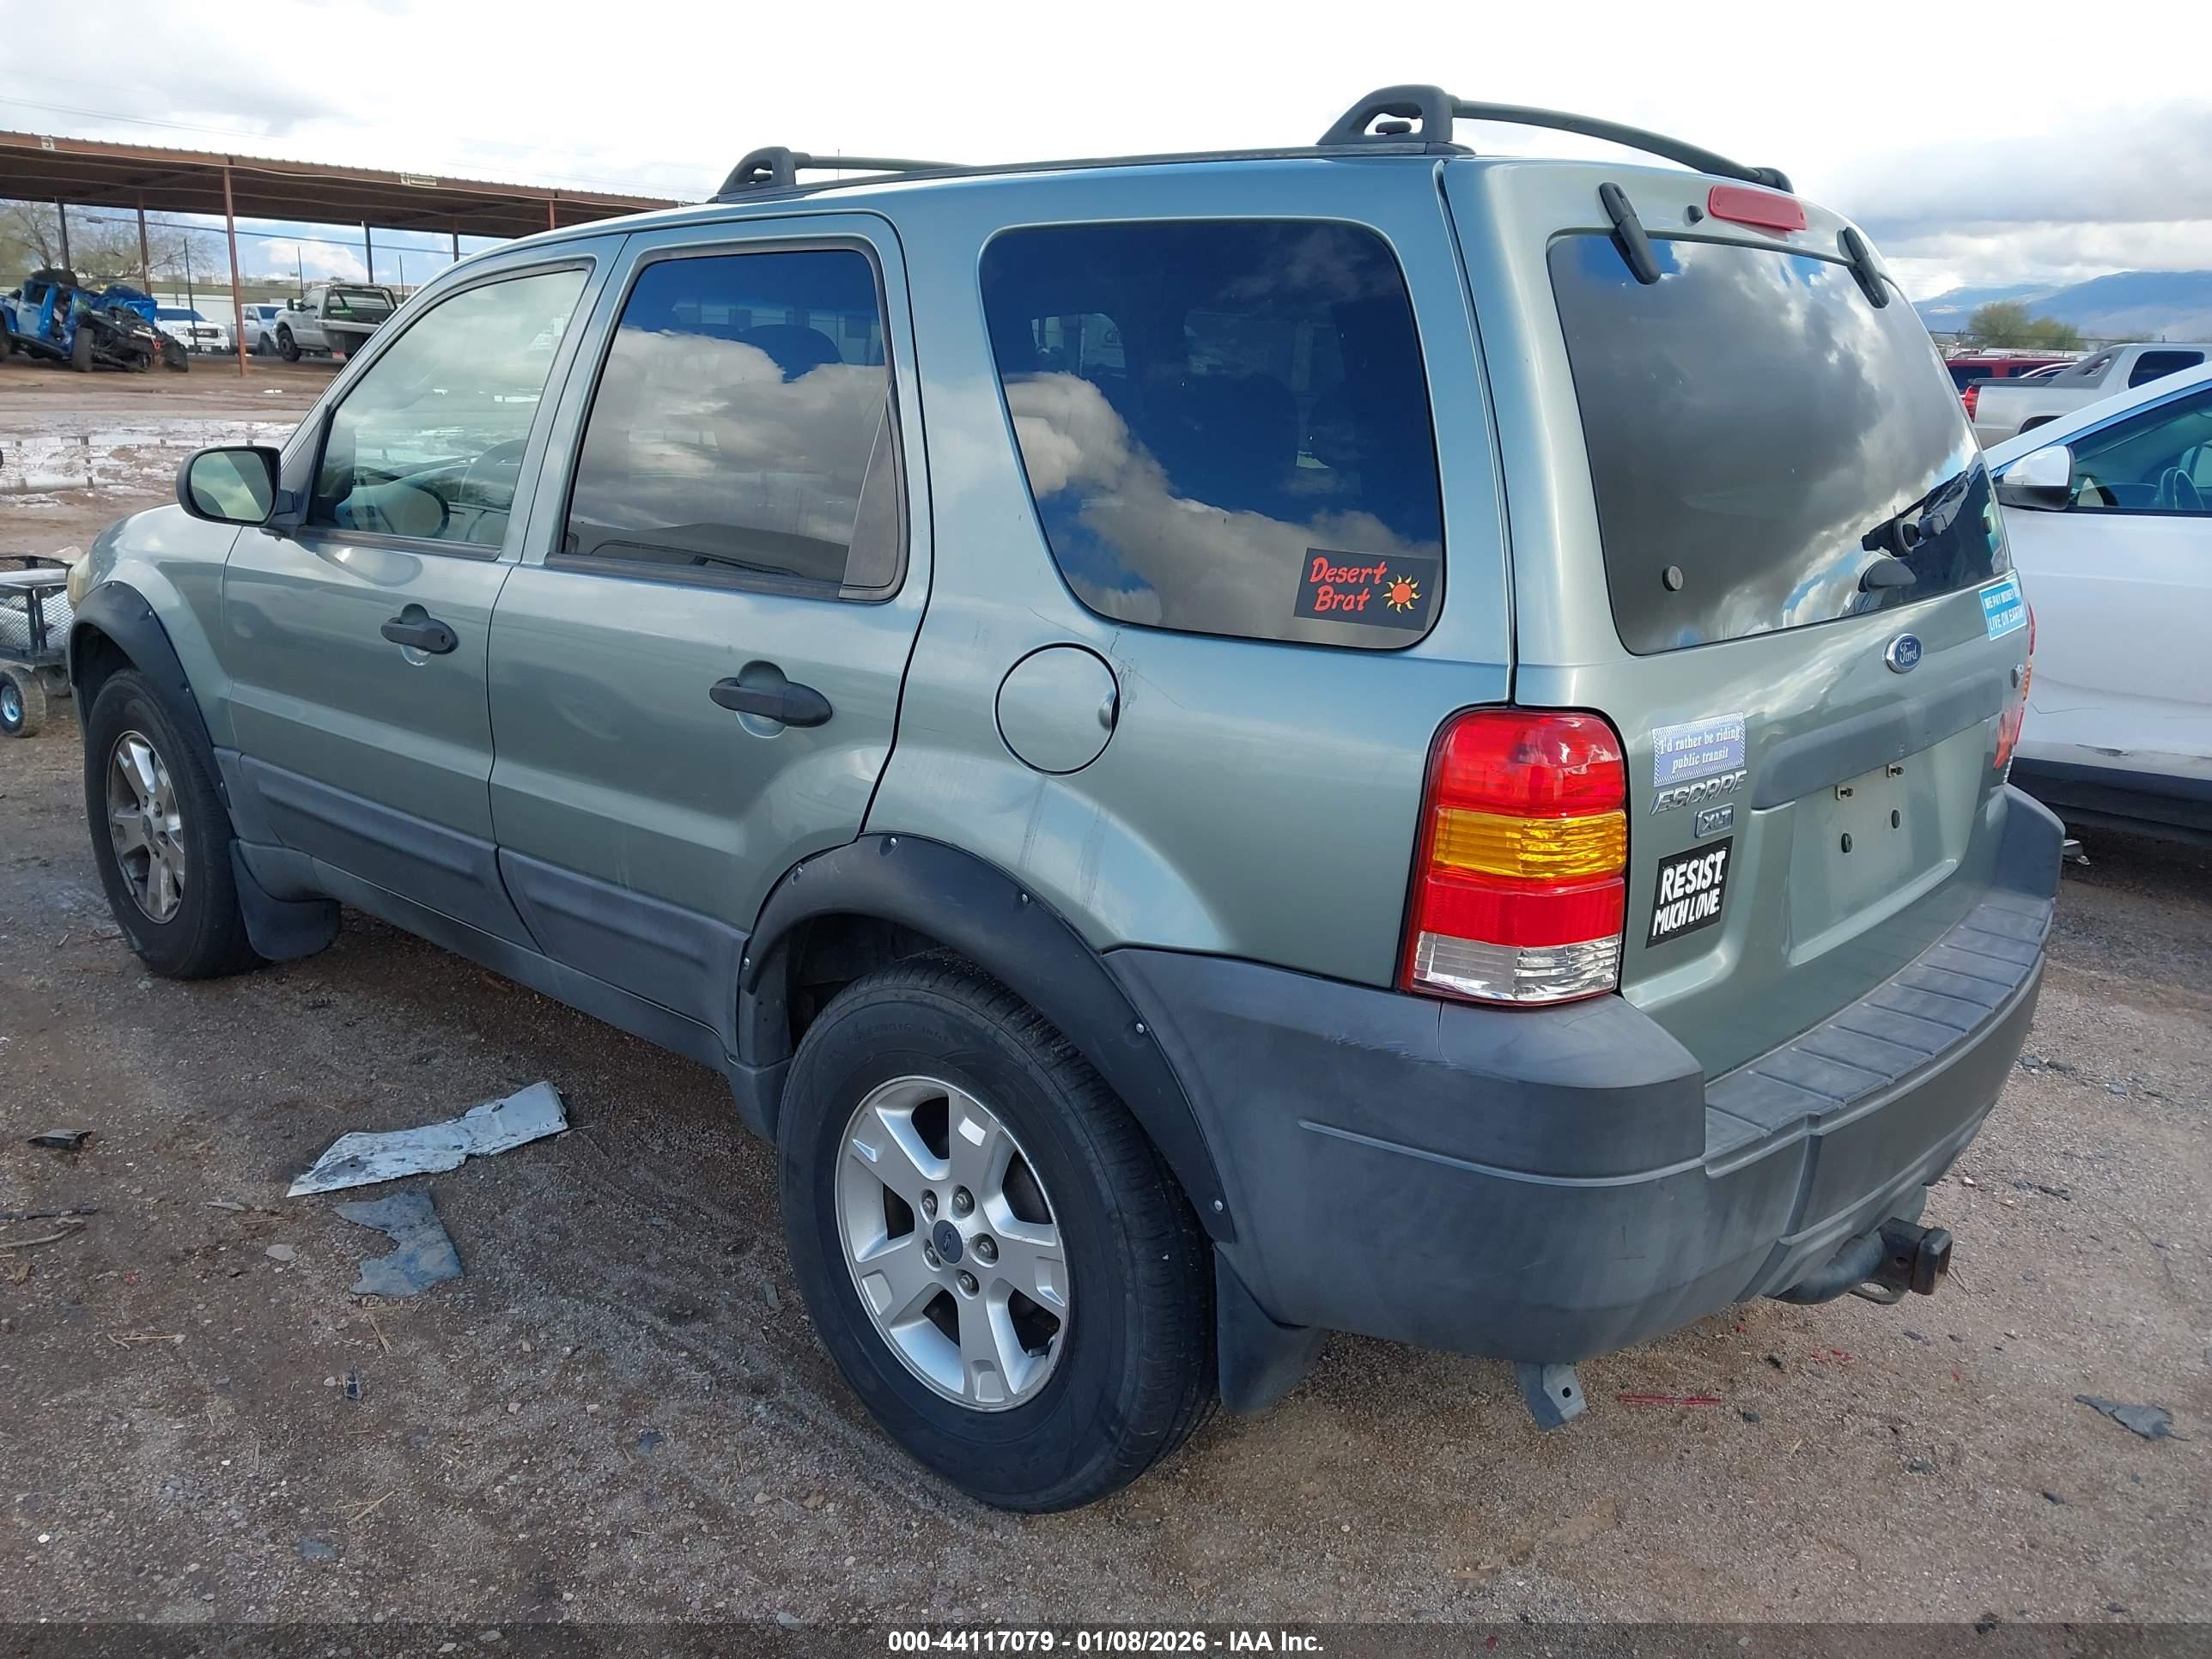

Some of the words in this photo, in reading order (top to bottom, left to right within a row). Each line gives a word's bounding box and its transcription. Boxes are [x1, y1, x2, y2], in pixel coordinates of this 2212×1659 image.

[1309, 556, 1388, 585] Desert
[1314, 585, 1370, 612] Brat
[1990, 614, 2002, 631] LIVE
[2002, 611, 2009, 626] ON
[2008, 605, 2023, 623] EARTH
[1899, 641, 1918, 663] Ford
[1658, 738, 1673, 755] I'd
[1675, 735, 1702, 751] rather
[1704, 732, 1714, 744] be
[1717, 726, 1741, 743] riding
[1672, 752, 1700, 775] public
[1702, 745, 1729, 763] transit
[1650, 769, 1747, 815] ESCAPE
[1702, 810, 1731, 831] XLT
[1660, 850, 1726, 905] RESIST.
[1653, 898, 1689, 936] MUCH
